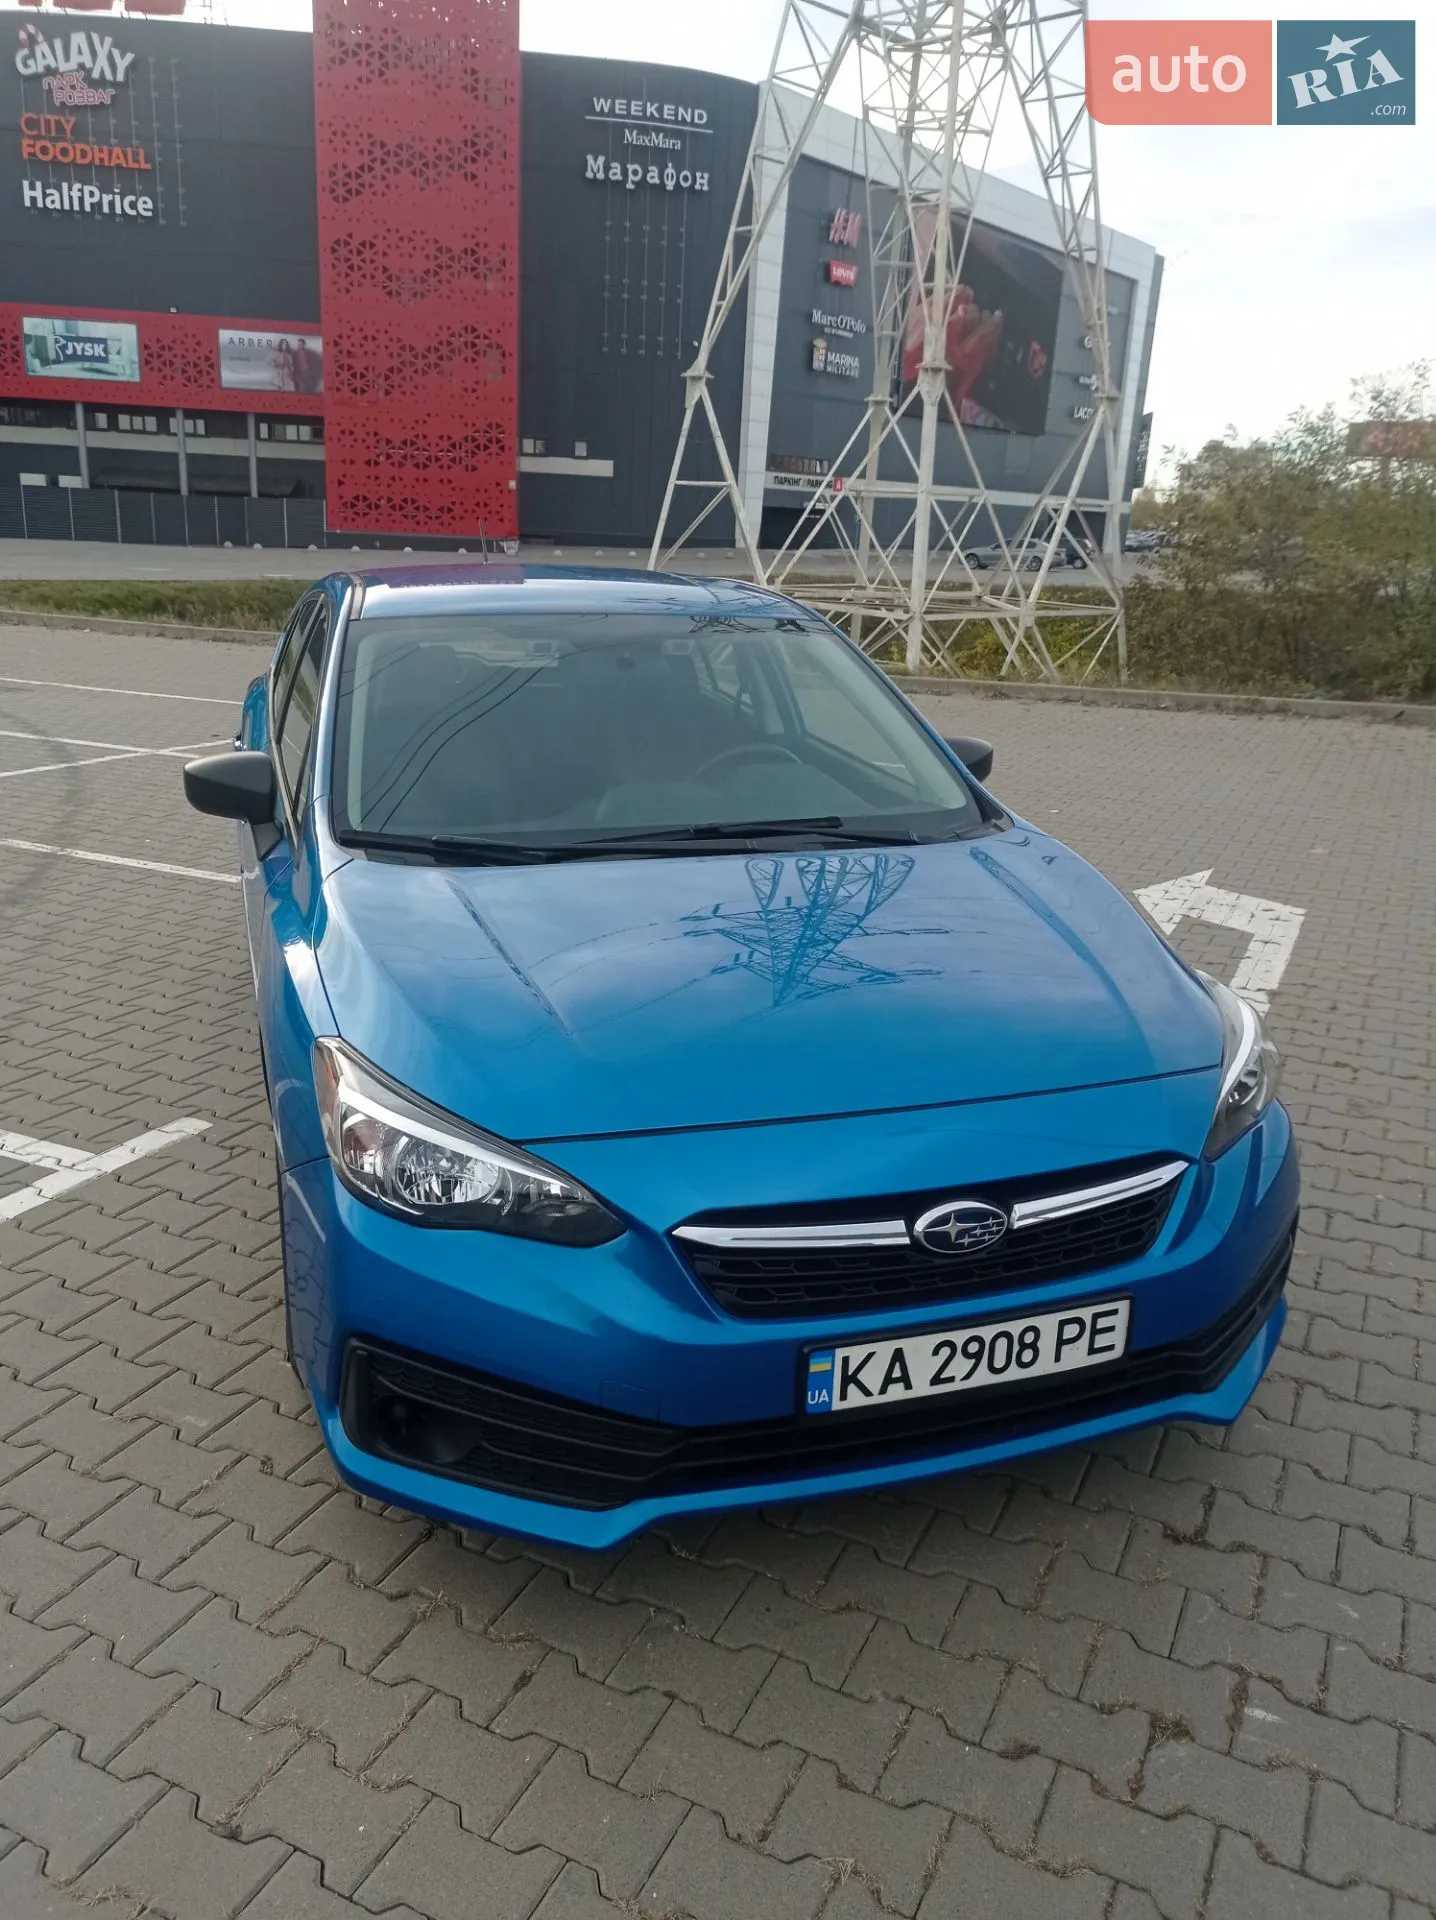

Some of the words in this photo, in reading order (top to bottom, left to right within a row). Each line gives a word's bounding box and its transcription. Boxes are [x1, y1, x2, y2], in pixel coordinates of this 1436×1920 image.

[15, 32, 135, 83] GALAXY
[43, 71, 88, 90] ПАРК
[592, 97, 708, 125] WEEKEND
[20, 112, 76, 138] CITY
[21, 139, 151, 170] FOODHALL
[585, 154, 710, 192] Марафон
[22, 180, 153, 217] HalfPrice
[64, 341, 107, 359] JYSK
[228, 337, 273, 348] ARBER
[827, 351, 859, 368] MARINA
[839, 1347, 913, 1403] KA
[929, 1326, 1041, 1387] 2908
[1054, 1307, 1120, 1364] PE
[807, 1389, 829, 1405] UA
